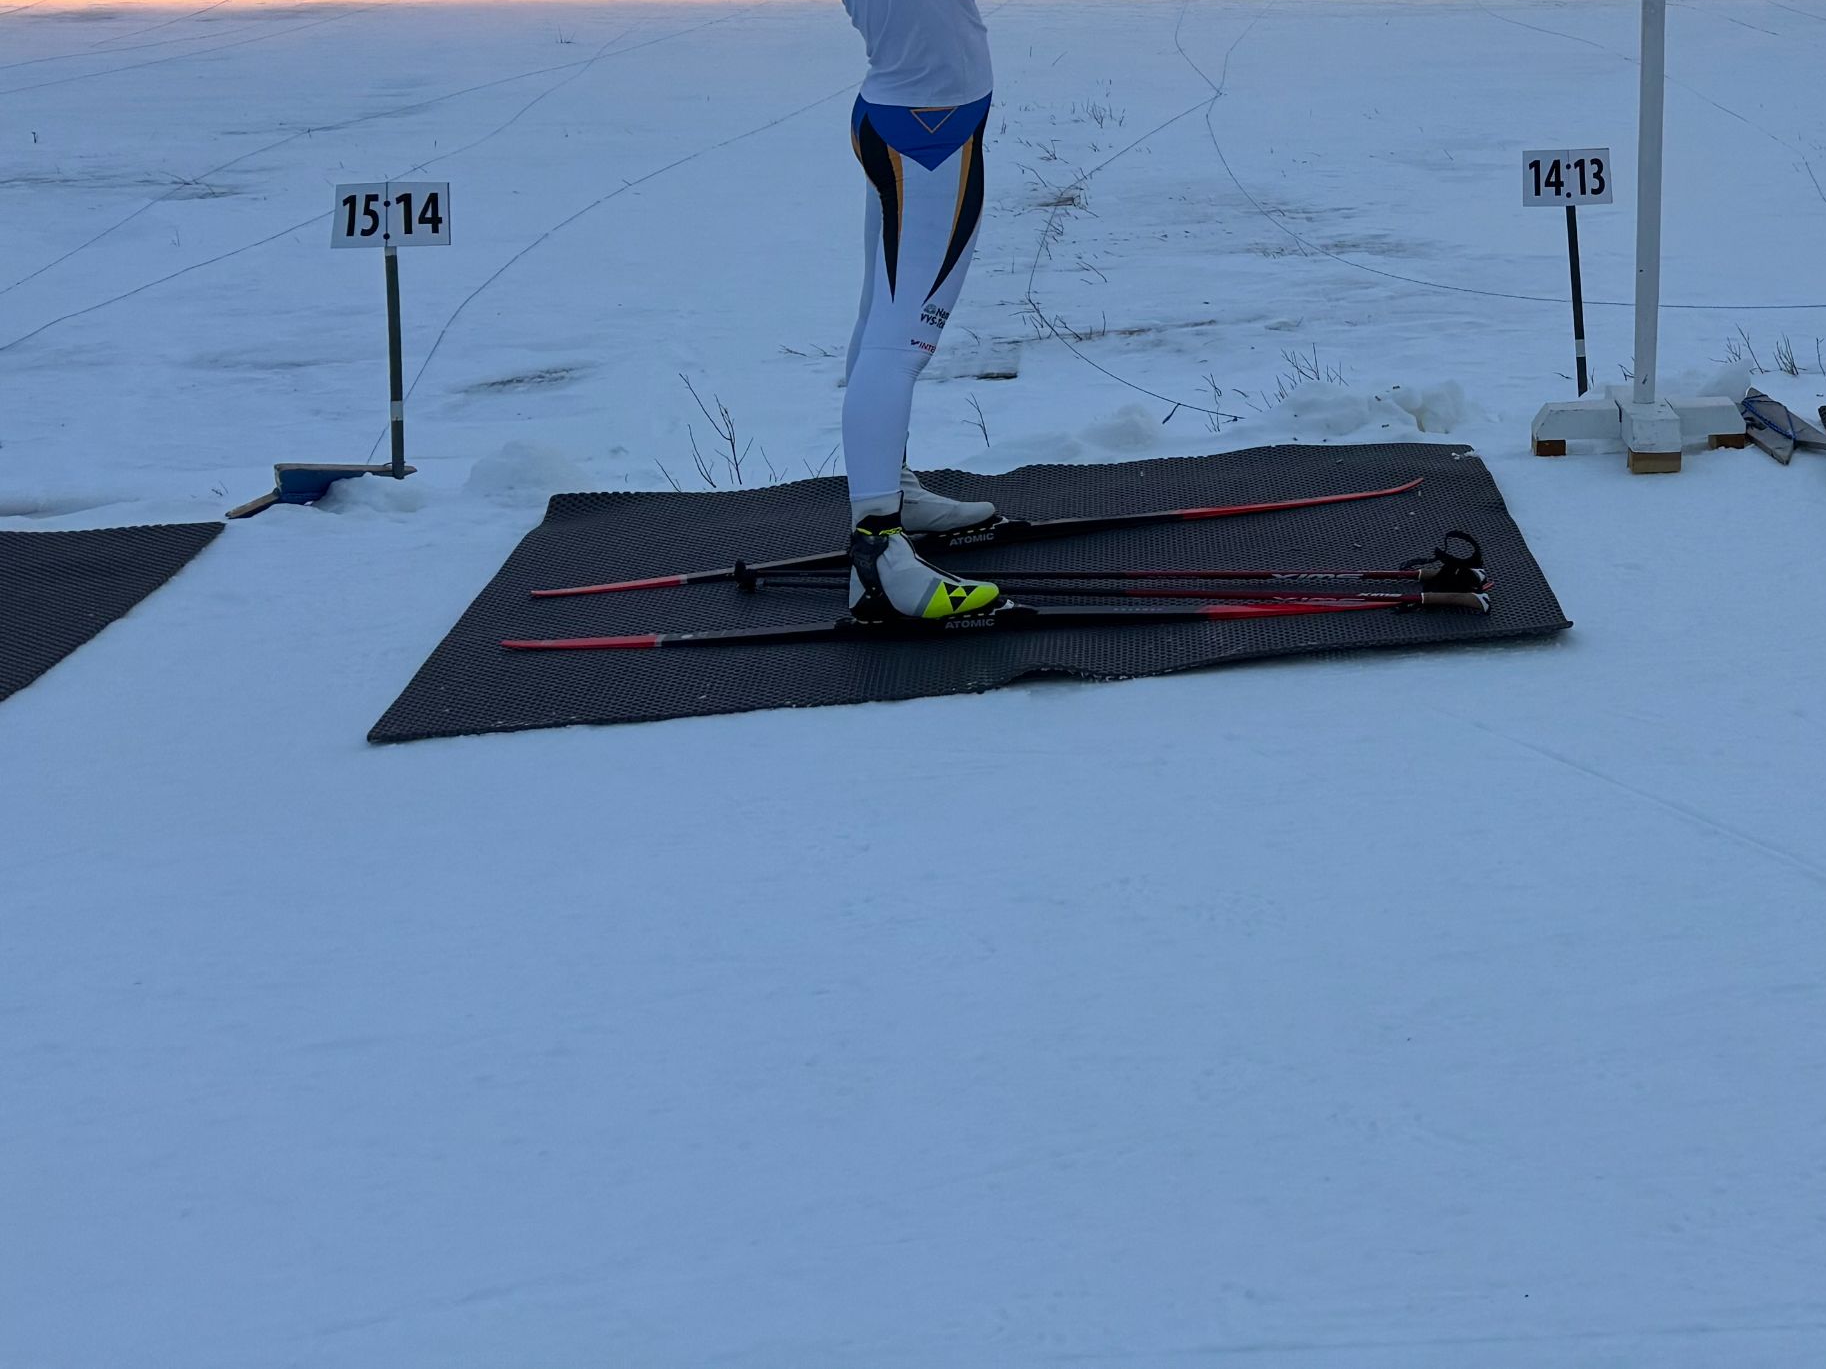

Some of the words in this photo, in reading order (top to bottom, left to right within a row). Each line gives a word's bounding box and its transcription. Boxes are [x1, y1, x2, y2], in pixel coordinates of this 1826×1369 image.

[1528, 158, 1565, 197] 14
[1573, 157, 1606, 196] 13
[342, 193, 380, 237] 15
[395, 192, 443, 235] 14
[949, 532, 995, 547] ATOMIC
[945, 618, 995, 630] ATOMIC
